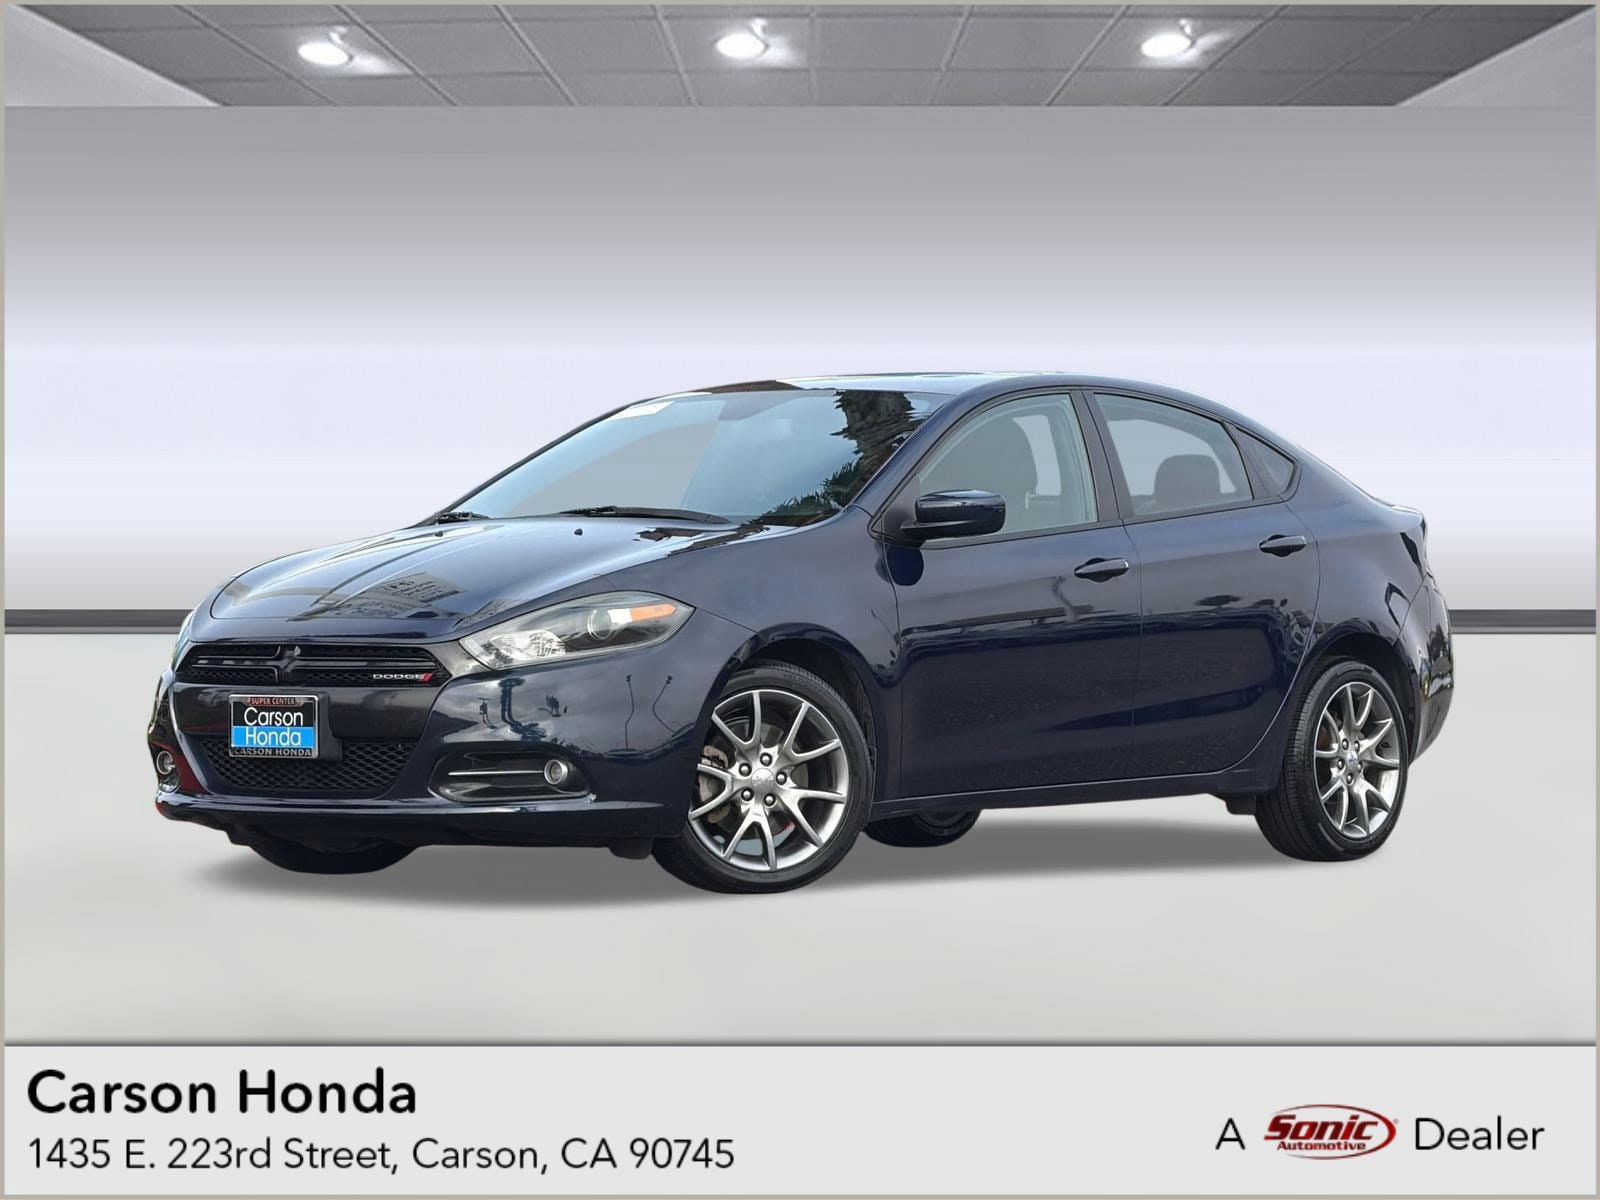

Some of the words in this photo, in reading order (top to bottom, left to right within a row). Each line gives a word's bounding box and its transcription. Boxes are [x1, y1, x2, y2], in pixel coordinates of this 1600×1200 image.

[372, 673, 421, 681] DODGE
[251, 697, 270, 705] SUPER
[272, 697, 295, 705] CENTER
[244, 706, 304, 727] Carson
[245, 727, 302, 747] Honda
[234, 748, 272, 756] CARSON
[276, 748, 312, 757] HONDA
